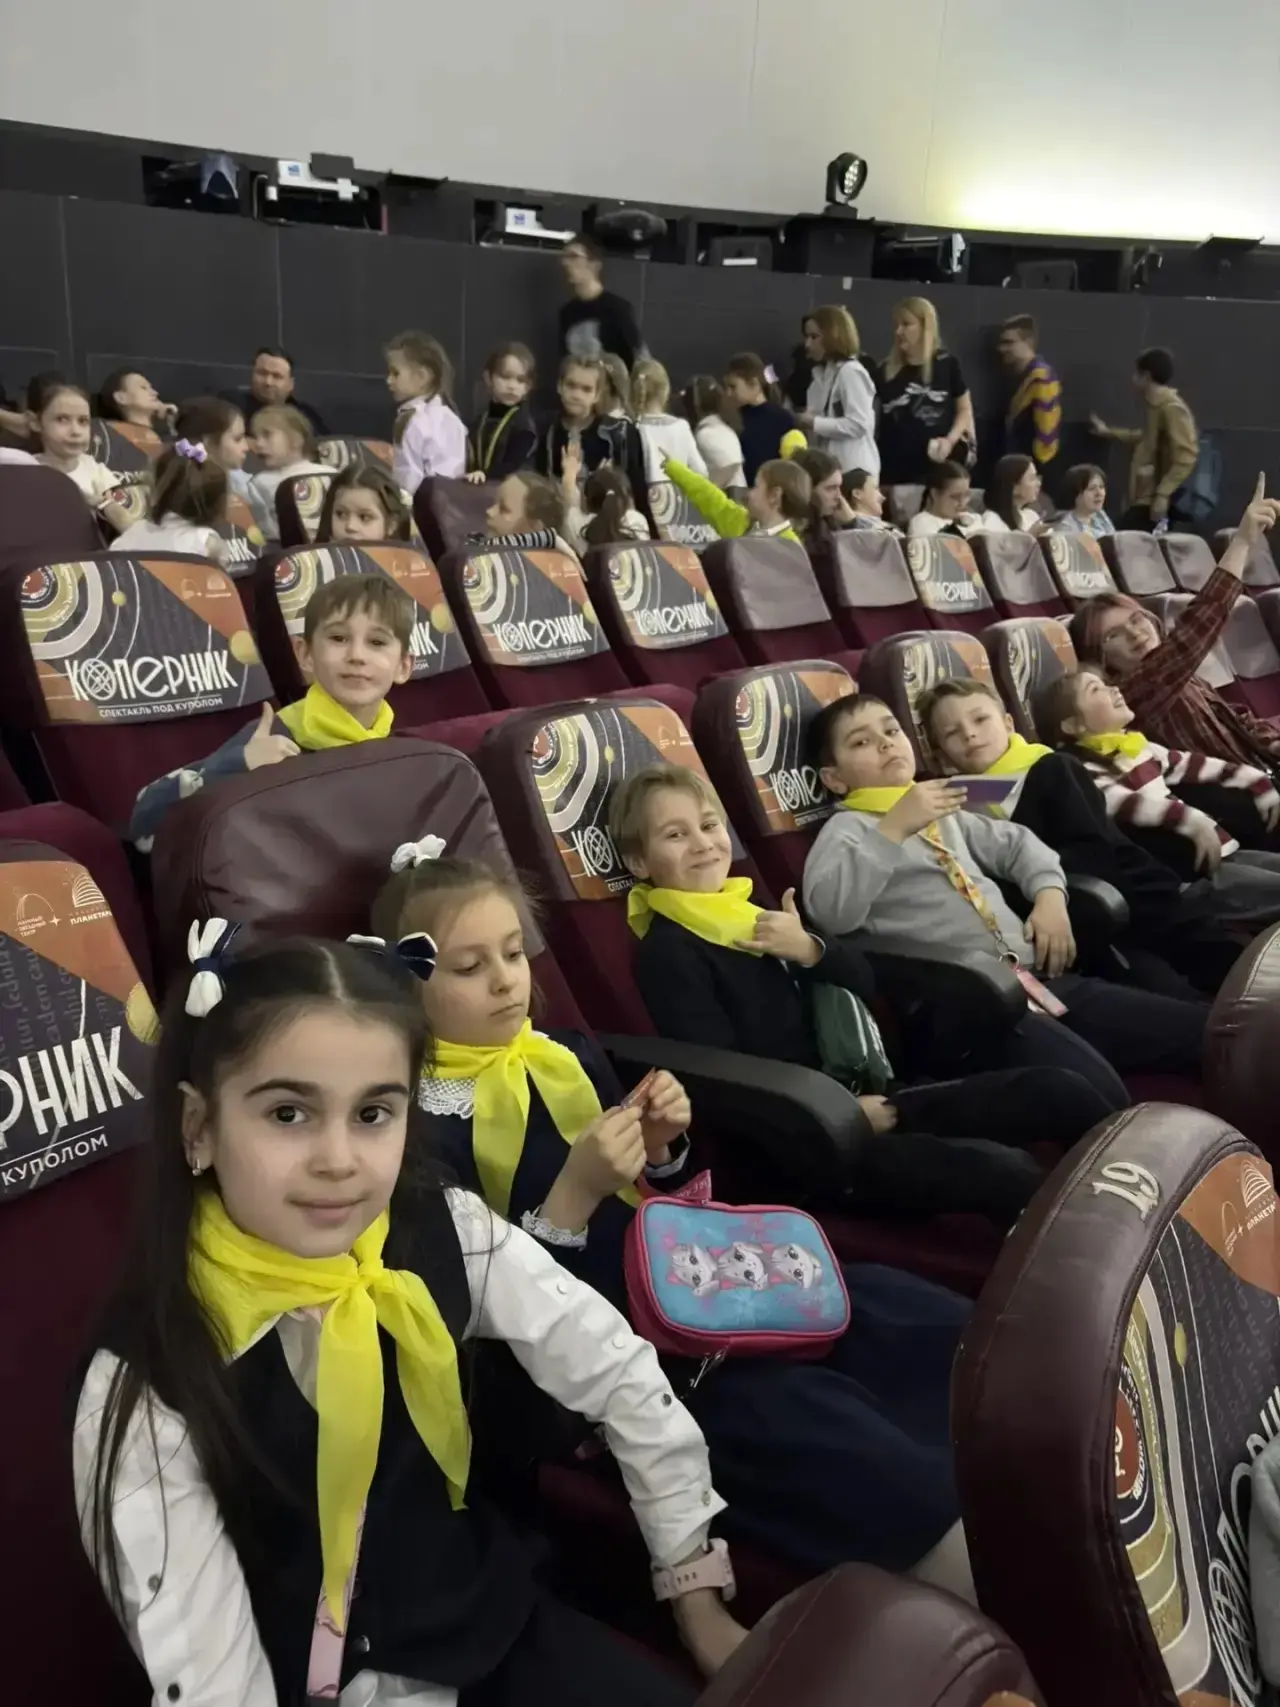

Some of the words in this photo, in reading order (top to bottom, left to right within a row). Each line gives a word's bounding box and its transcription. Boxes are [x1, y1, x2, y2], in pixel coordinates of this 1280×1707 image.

[99, 706, 152, 718] СПЕКТАКЛЬ
[153, 704, 175, 714] ПОД
[175, 697, 224, 711] КУПОЛОМ
[1, 1133, 108, 1186] КУПОЛОМ
[1092, 1162, 1159, 1220] 19
